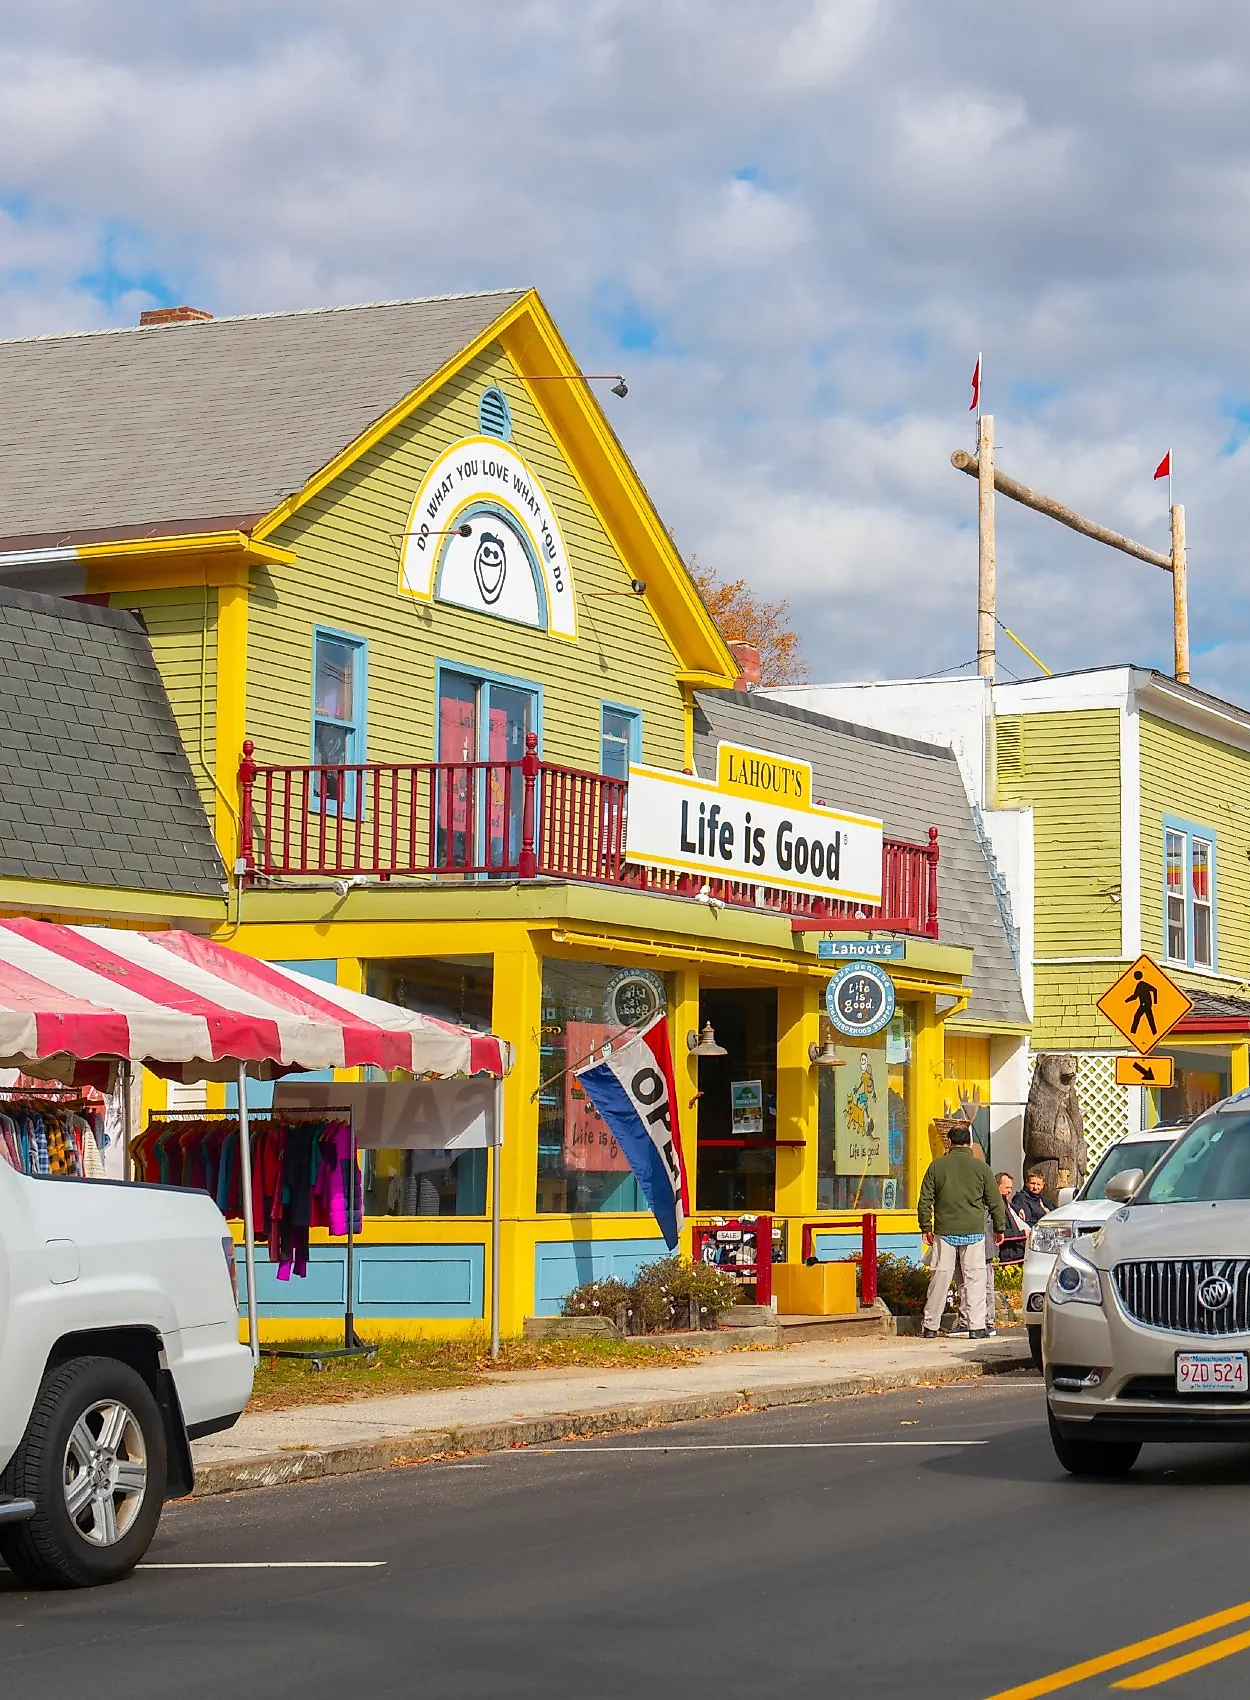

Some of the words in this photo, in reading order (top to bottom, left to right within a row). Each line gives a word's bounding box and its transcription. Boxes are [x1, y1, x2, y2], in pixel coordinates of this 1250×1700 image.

[417, 523, 430, 551] DO
[426, 473, 454, 519] WHAT
[456, 460, 478, 481] YOU
[482, 460, 509, 483] LOVE
[513, 474, 540, 516] WHAT
[541, 521, 556, 559] YOU
[552, 566, 564, 593] DO
[728, 755, 802, 798] LAHOUT'S
[680, 800, 734, 861] Life
[744, 812, 766, 866] is
[776, 820, 840, 881] Good
[832, 944, 892, 954] Lahout's
[849, 980, 870, 993] Life
[856, 992, 866, 1000] is
[572, 1123, 594, 1146] Life
[599, 1130, 608, 1146] is
[850, 1144, 860, 1159] Life
[861, 1146, 866, 1158] is
[1181, 1364, 1209, 1382] 9ZD
[1214, 1364, 1242, 1382] 524
